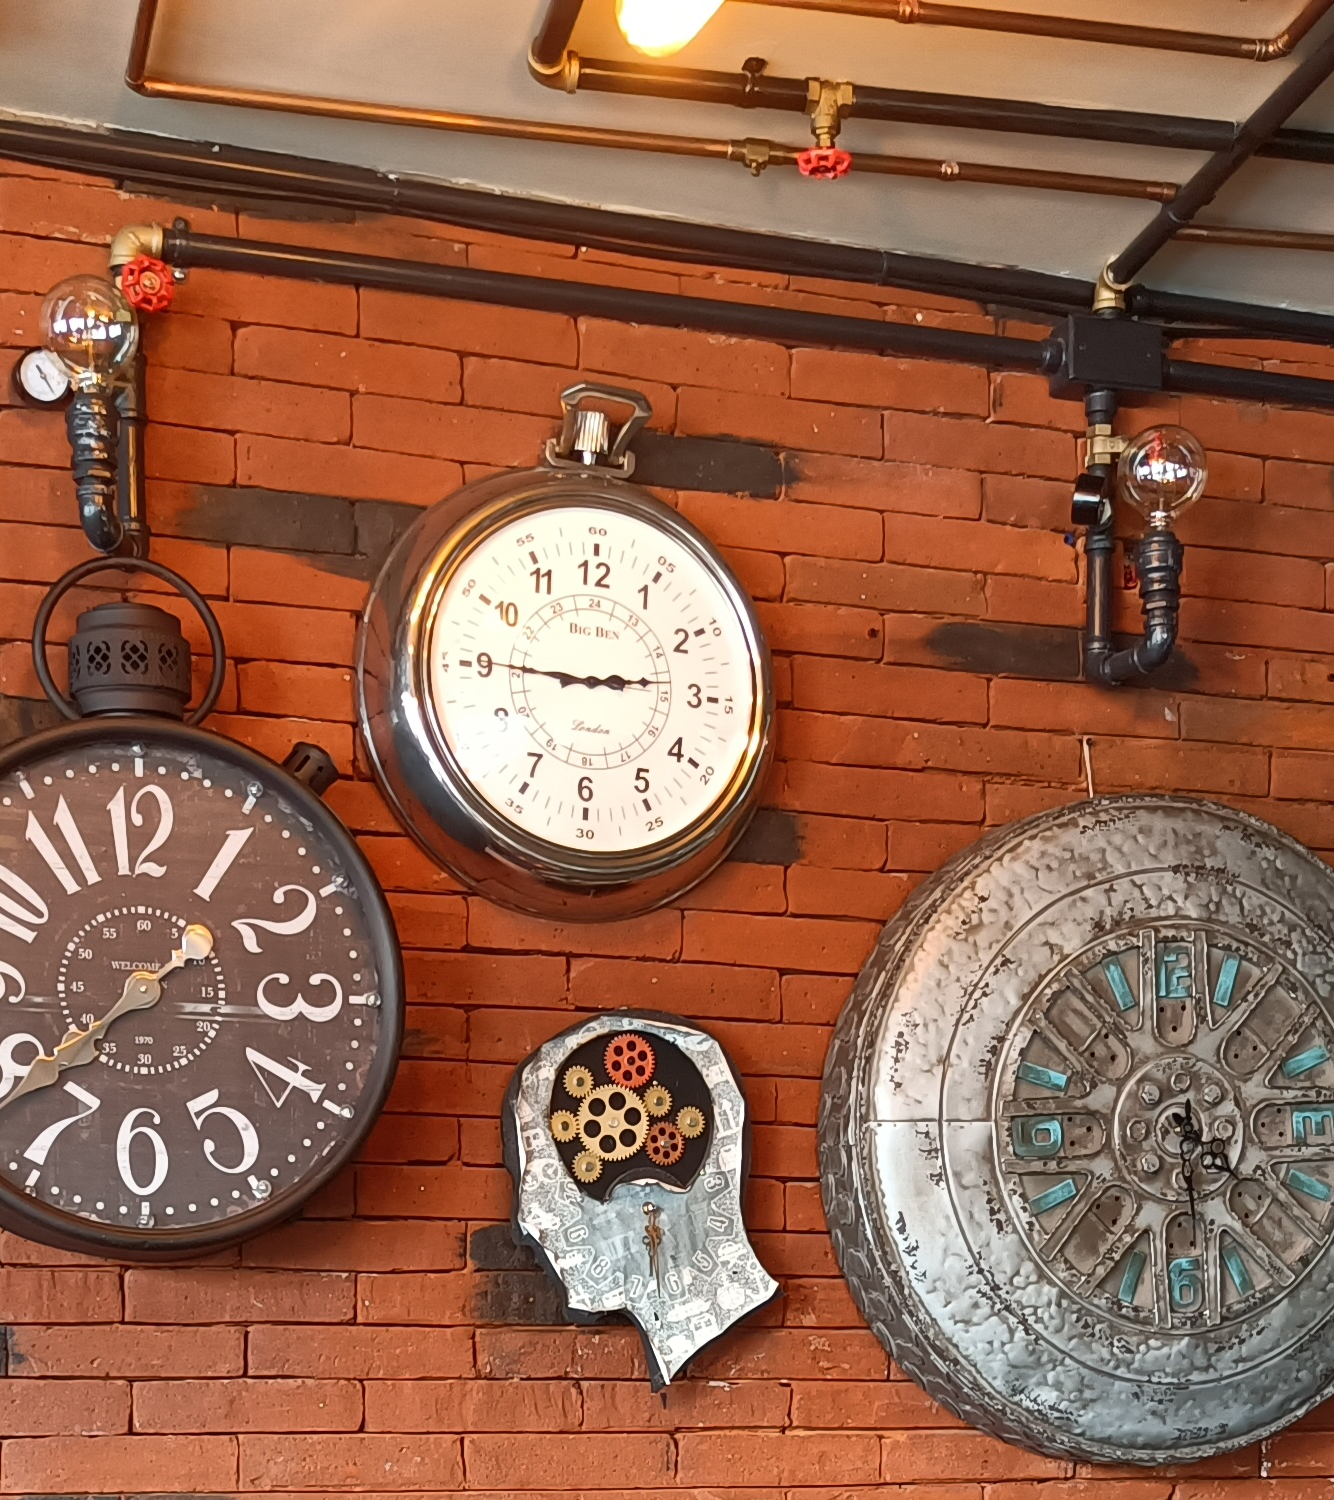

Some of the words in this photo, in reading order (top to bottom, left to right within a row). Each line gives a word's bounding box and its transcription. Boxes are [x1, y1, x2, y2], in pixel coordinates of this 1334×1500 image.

[516, 533, 534, 547] 55
[588, 526, 607, 537] 60
[657, 555, 676, 573] 05
[530, 567, 553, 595] 11
[577, 560, 611, 589] 12
[461, 579, 477, 597] 50
[637, 584, 648, 611] 1
[494, 600, 519, 627] 10
[588, 599, 601, 609] 24
[628, 614, 639, 627] 13
[708, 618, 722, 637] 10
[673, 628, 689, 654] 2
[477, 652, 493, 678] 9
[686, 683, 702, 708] 3
[723, 696, 734, 715] 15
[571, 719, 610, 735] London
[667, 737, 684, 762] 4
[527, 752, 544, 778] 7
[634, 768, 650, 793] 5
[700, 766, 715, 786] 20
[577, 776, 594, 801] 6
[505, 797, 524, 815] 35
[106, 784, 173, 877] 12
[575, 829, 594, 840] 30
[645, 817, 664, 832] 25
[25, 793, 102, 896] 11
[193, 827, 254, 901] 1
[136, 920, 152, 931] 60
[231, 885, 317, 954] 2
[102, 928, 117, 939] 55
[170, 928, 179, 939] 5
[78, 948, 93, 960] 50
[1158, 951, 1192, 999] 12
[70, 981, 85, 992] 45
[201, 987, 214, 998] 15
[256, 972, 342, 1022] 3
[80, 1013, 95, 1024] 40
[196, 1021, 211, 1032] 20
[101, 1043, 117, 1053] 35
[134, 1036, 154, 1045] 1970
[137, 1054, 152, 1065] 30
[172, 1046, 187, 1056] 25
[245, 1047, 327, 1109] 4
[23, 1081, 101, 1165] 7
[186, 1088, 259, 1173] 5
[116, 1108, 168, 1195] 6
[703, 1174, 725, 1192] 3
[707, 1215, 729, 1232] 4
[590, 1256, 611, 1278] 8
[692, 1250, 713, 1272] 5
[629, 1275, 643, 1298] 7
[665, 1271, 682, 1294] 6
[1169, 1257, 1203, 1308] 6
